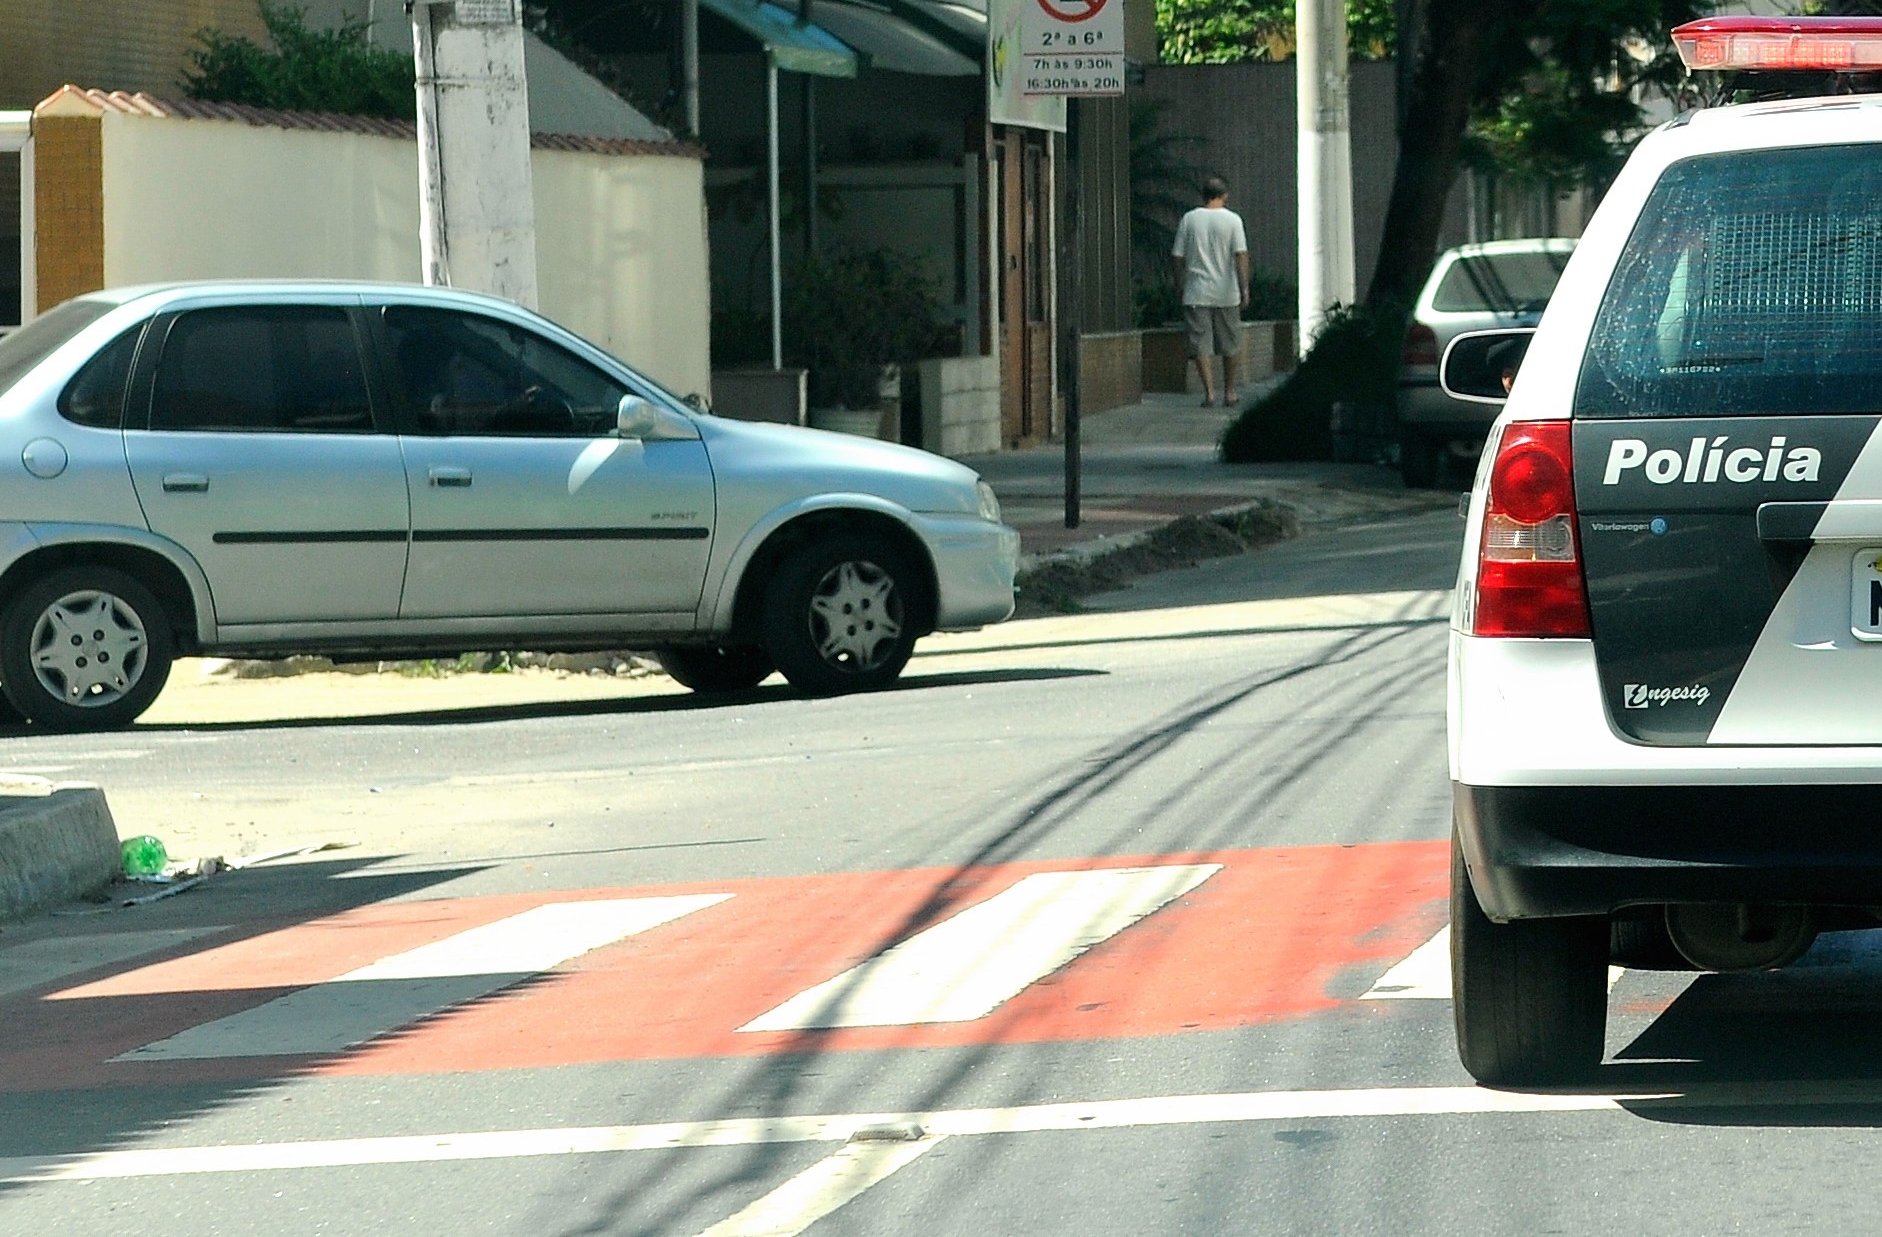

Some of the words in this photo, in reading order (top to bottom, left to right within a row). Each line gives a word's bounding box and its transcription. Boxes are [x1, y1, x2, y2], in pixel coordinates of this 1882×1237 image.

[1067, 35, 1077, 46] a
[1033, 59, 1050, 70] 7h
[1074, 59, 1113, 70] 9:30h
[1027, 79, 1069, 90] 16:30h
[1094, 77, 1120, 89] 20h
[1603, 436, 1822, 485] Polícia
[1623, 684, 1711, 709] Engesig
